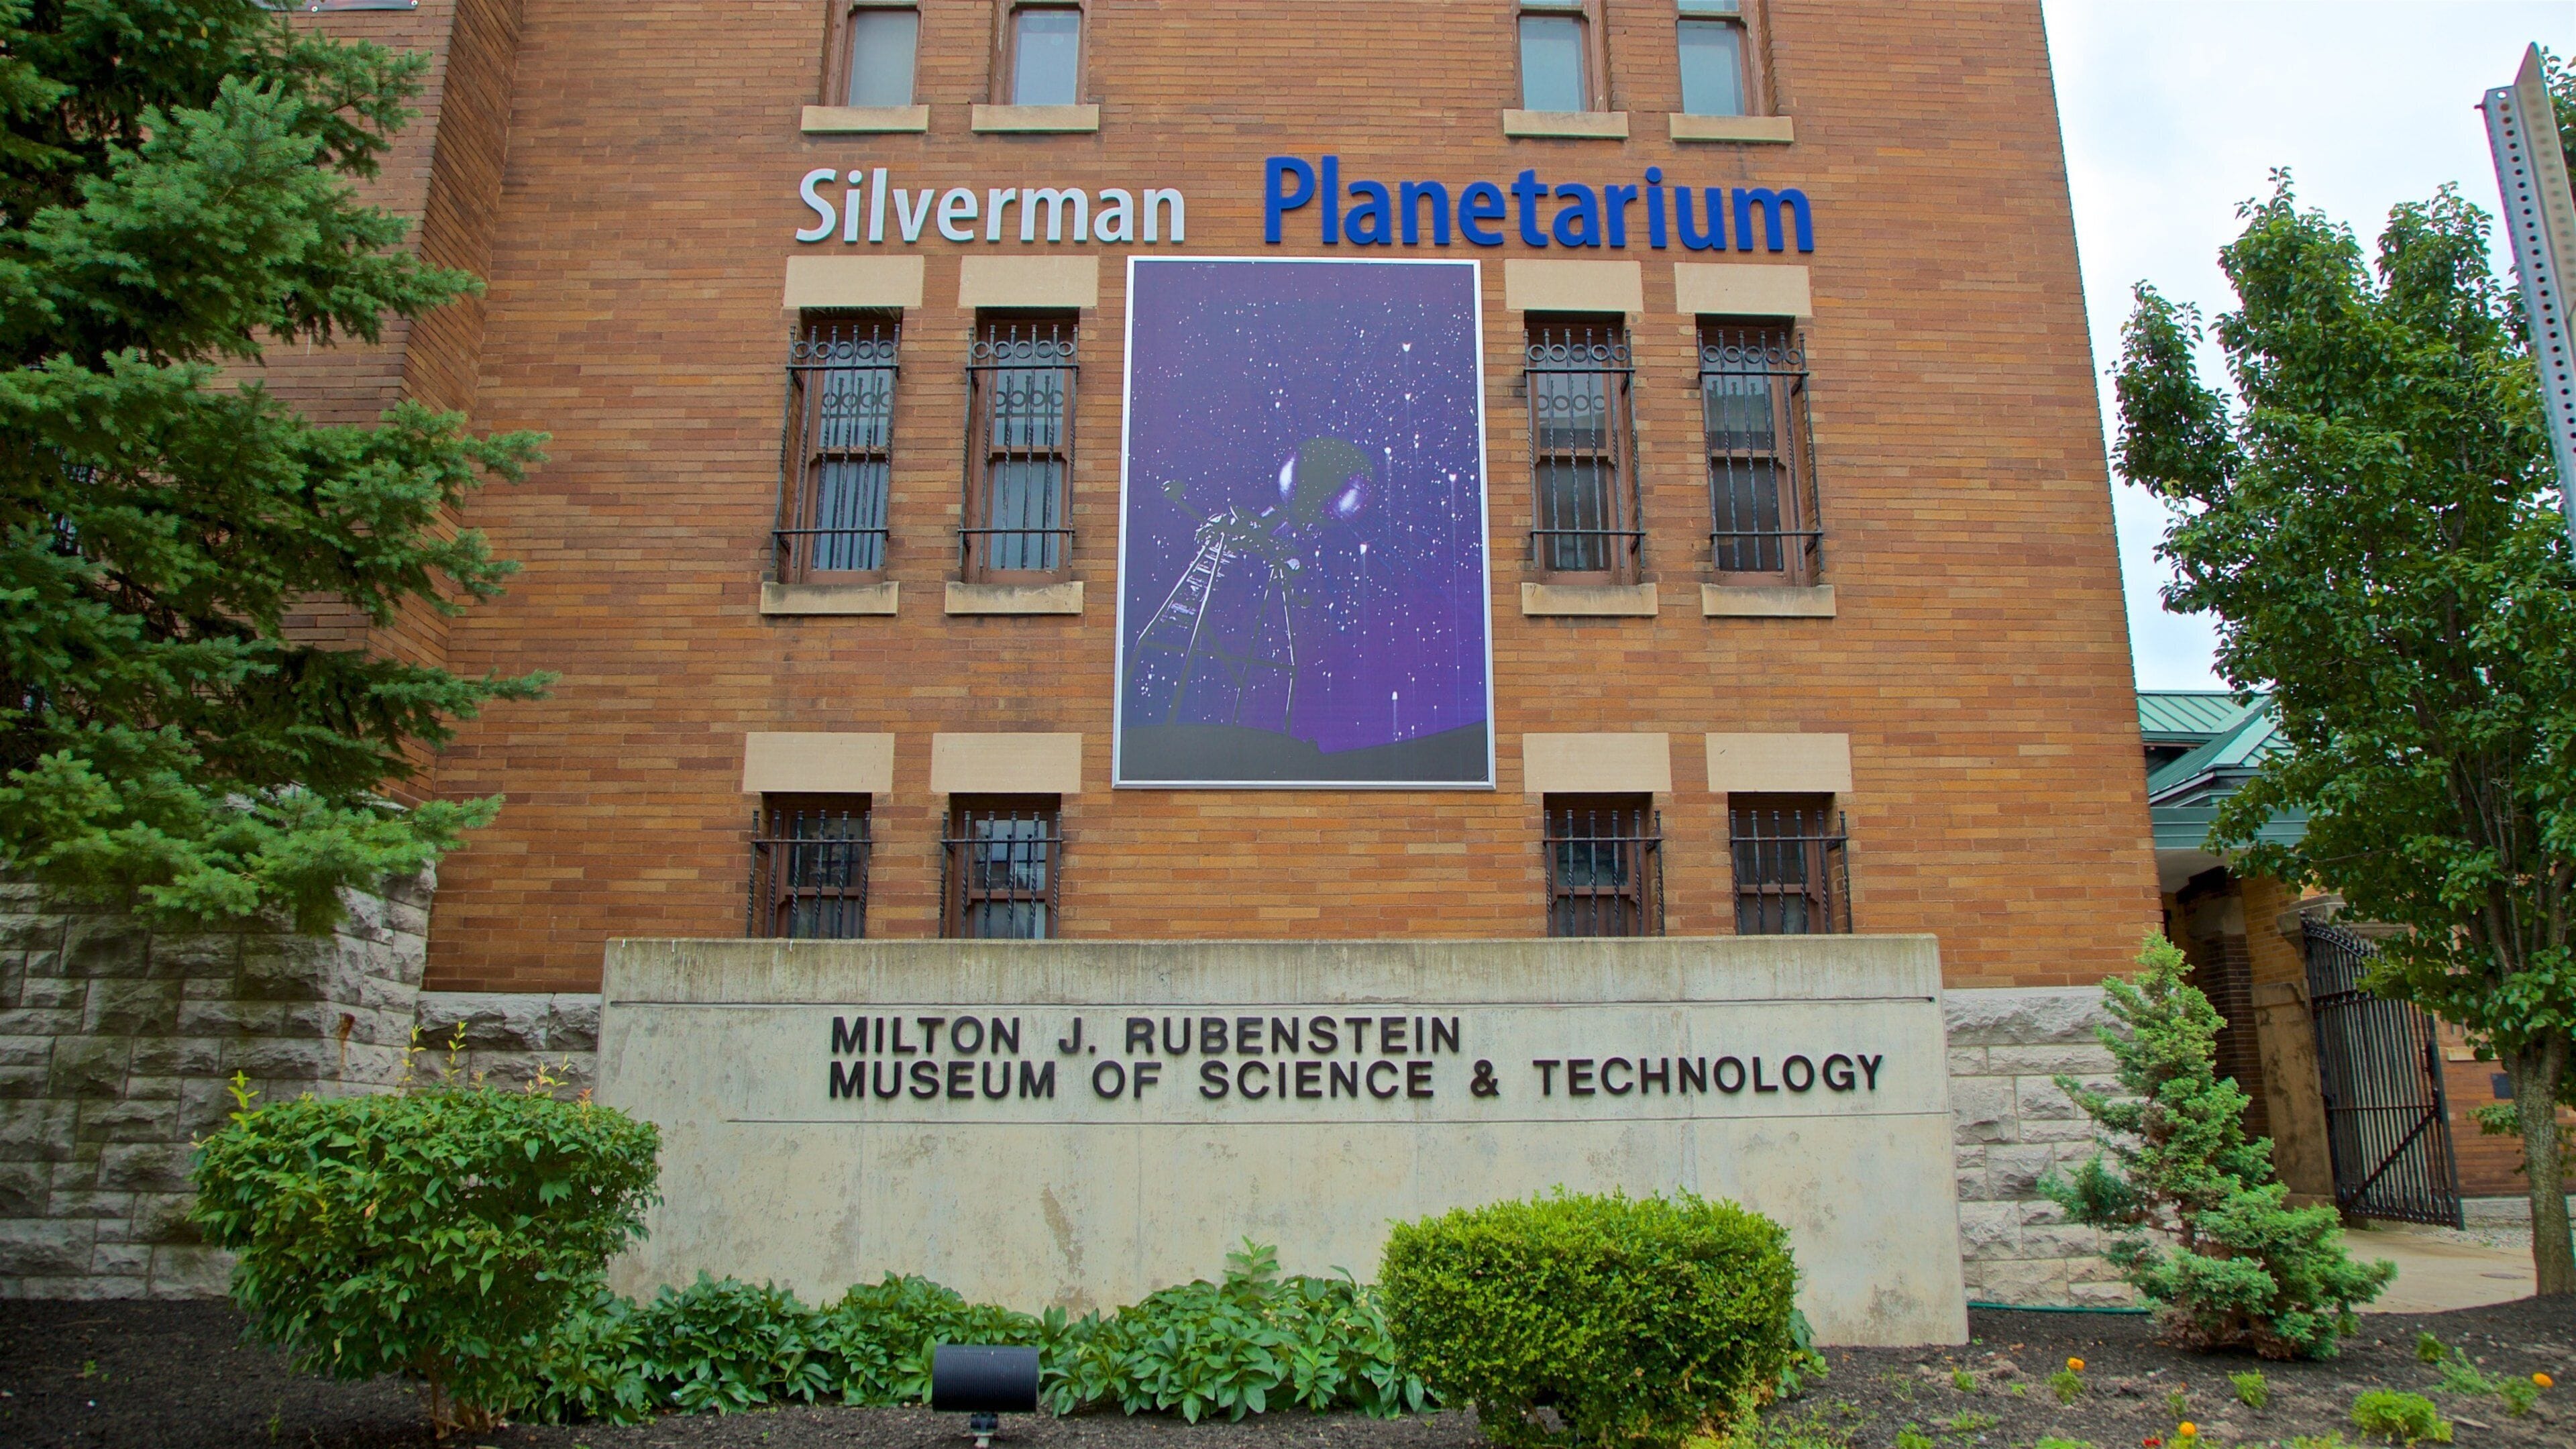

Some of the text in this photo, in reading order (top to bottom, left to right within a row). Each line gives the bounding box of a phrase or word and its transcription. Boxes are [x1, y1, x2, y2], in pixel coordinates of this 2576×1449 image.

[795, 154, 1815, 253] Silverman Planetarium
[830, 1016, 1460, 1057] MILTON J. RUBENSTEIN
[828, 1053, 1884, 1102] MUSEUM OF SCIENCE & TECHNOLOGY
